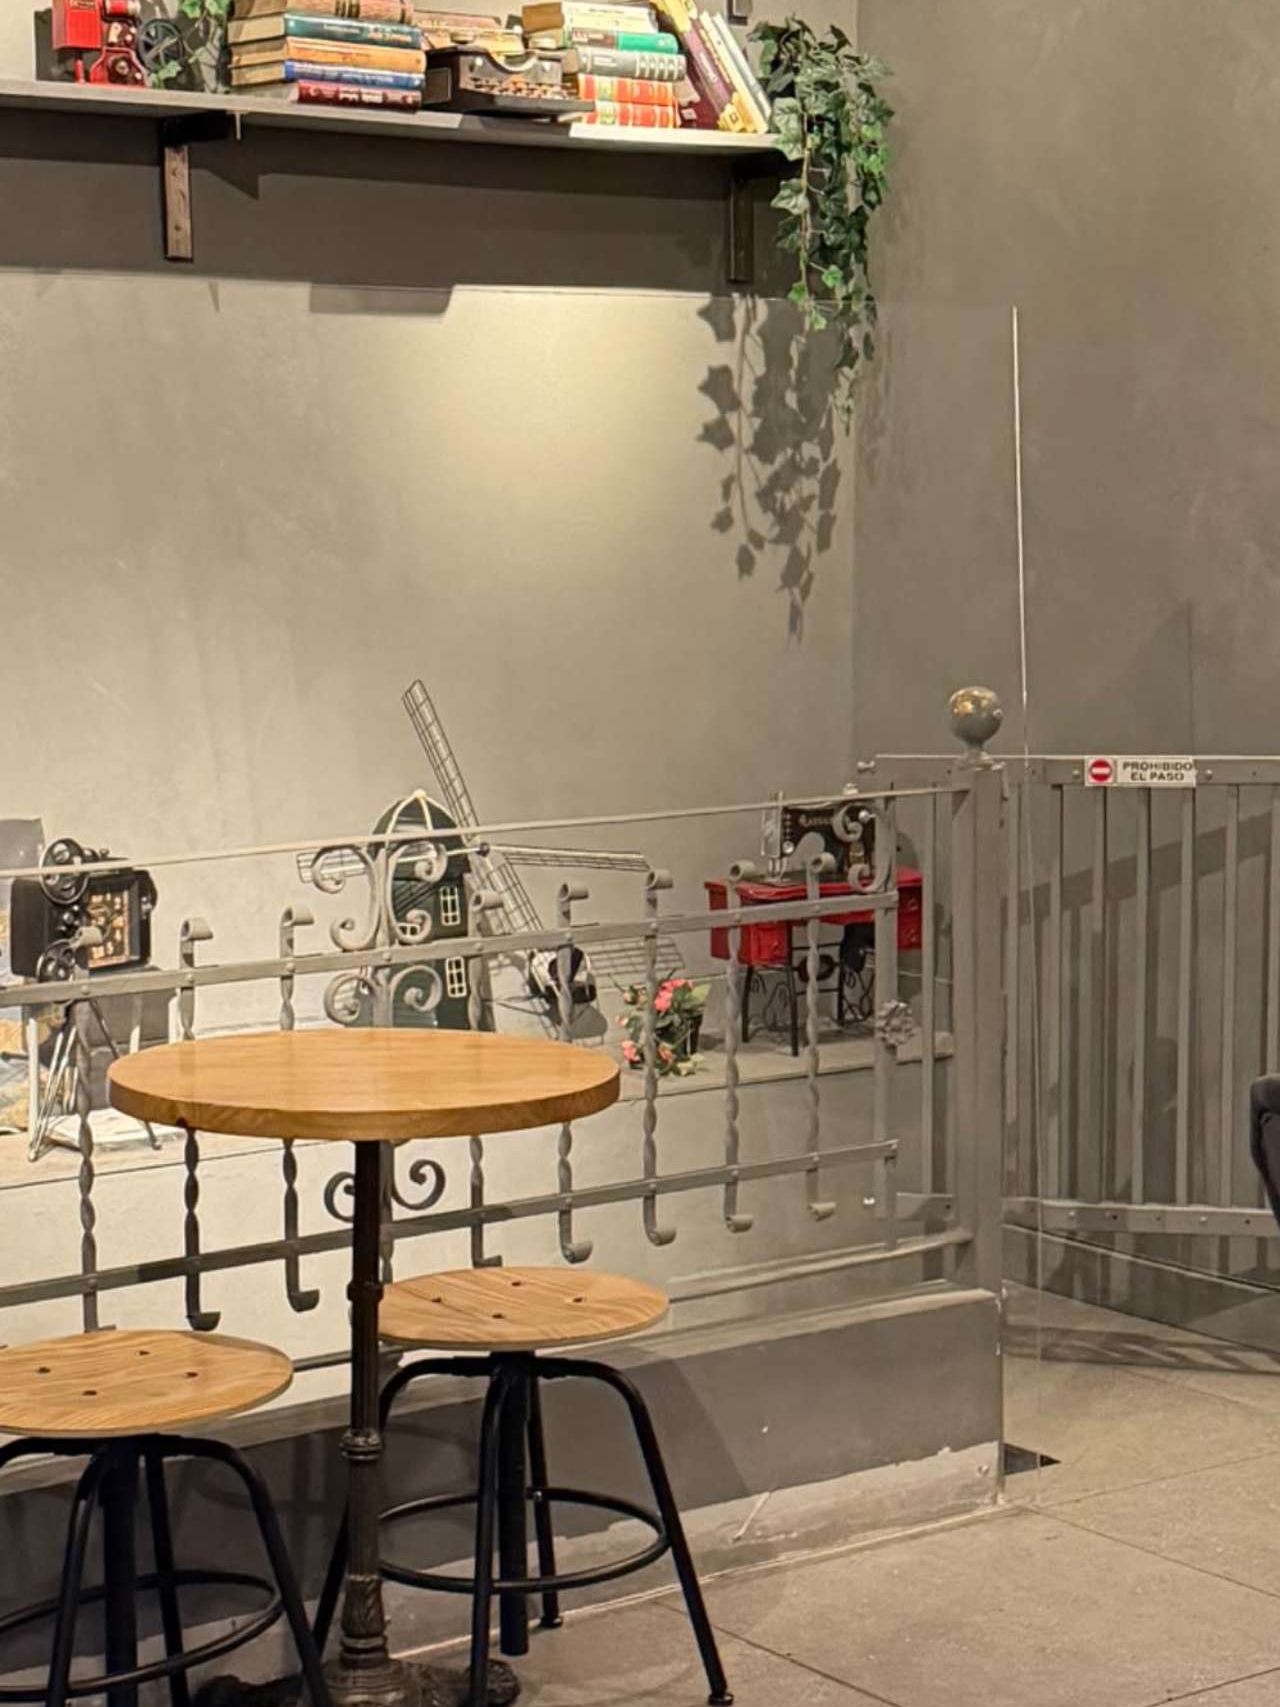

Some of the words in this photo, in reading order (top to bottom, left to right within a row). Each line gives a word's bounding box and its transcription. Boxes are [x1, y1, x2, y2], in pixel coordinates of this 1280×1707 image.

[1122, 761, 1193, 772] PROHIBIDO
[1130, 772, 1147, 781] EL
[1150, 772, 1184, 781] PASO
